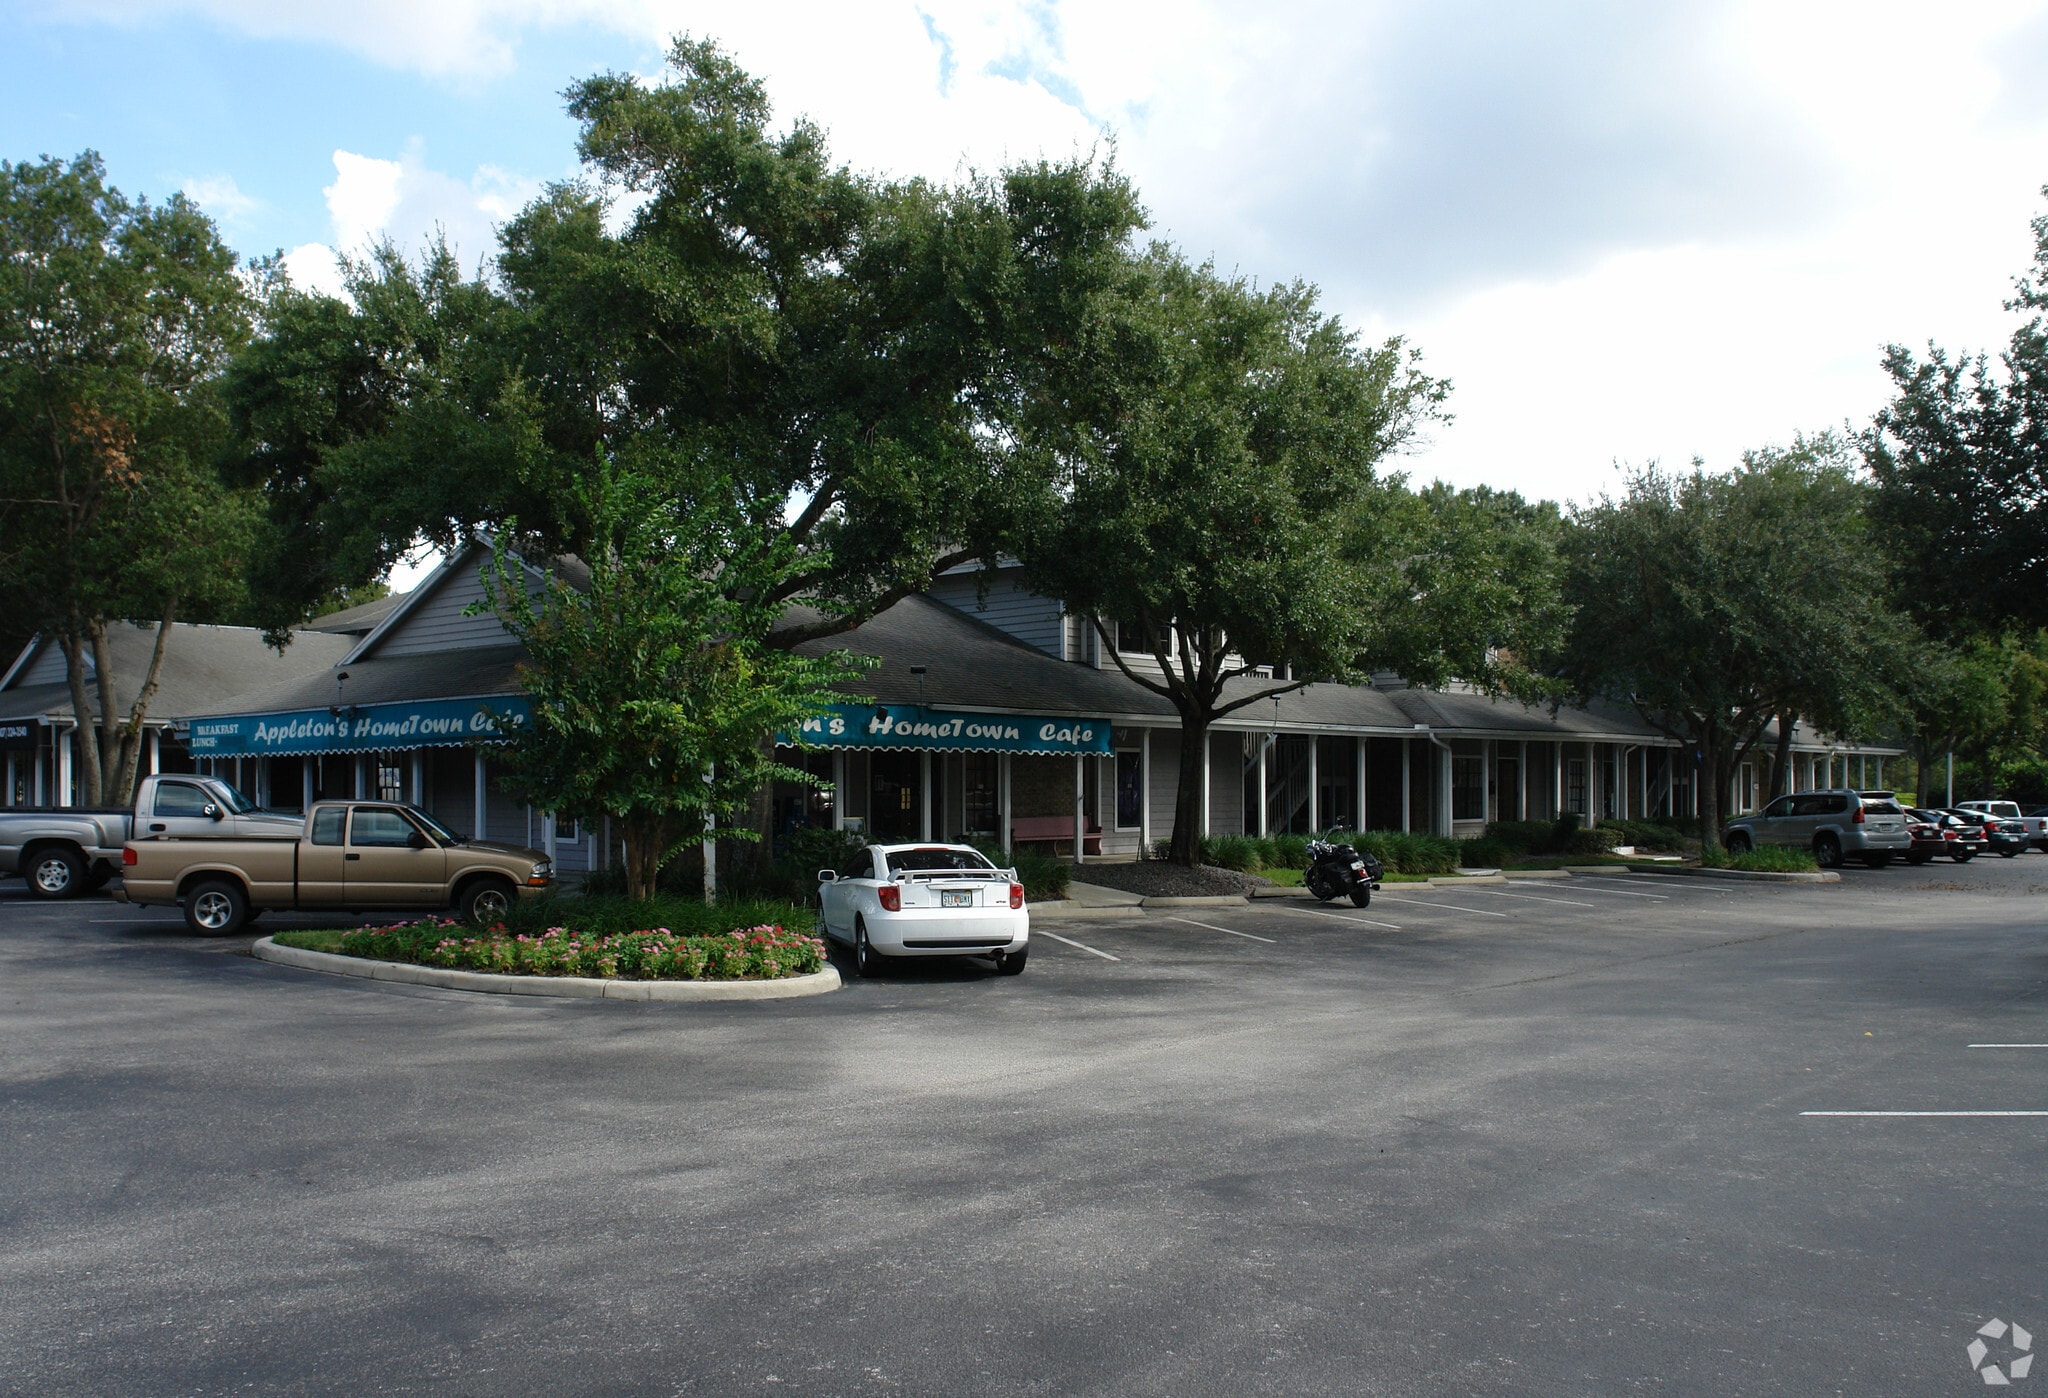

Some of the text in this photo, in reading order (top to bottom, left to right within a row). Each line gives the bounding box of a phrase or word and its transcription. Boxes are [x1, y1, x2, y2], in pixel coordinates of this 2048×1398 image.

[197, 724, 239, 735] BREAKFAST
[254, 718, 348, 745] Appleton's
[354, 715, 463, 738] HomeTown
[869, 716, 1019, 739] HomeTown
[1039, 723, 1093, 745] Cafe
